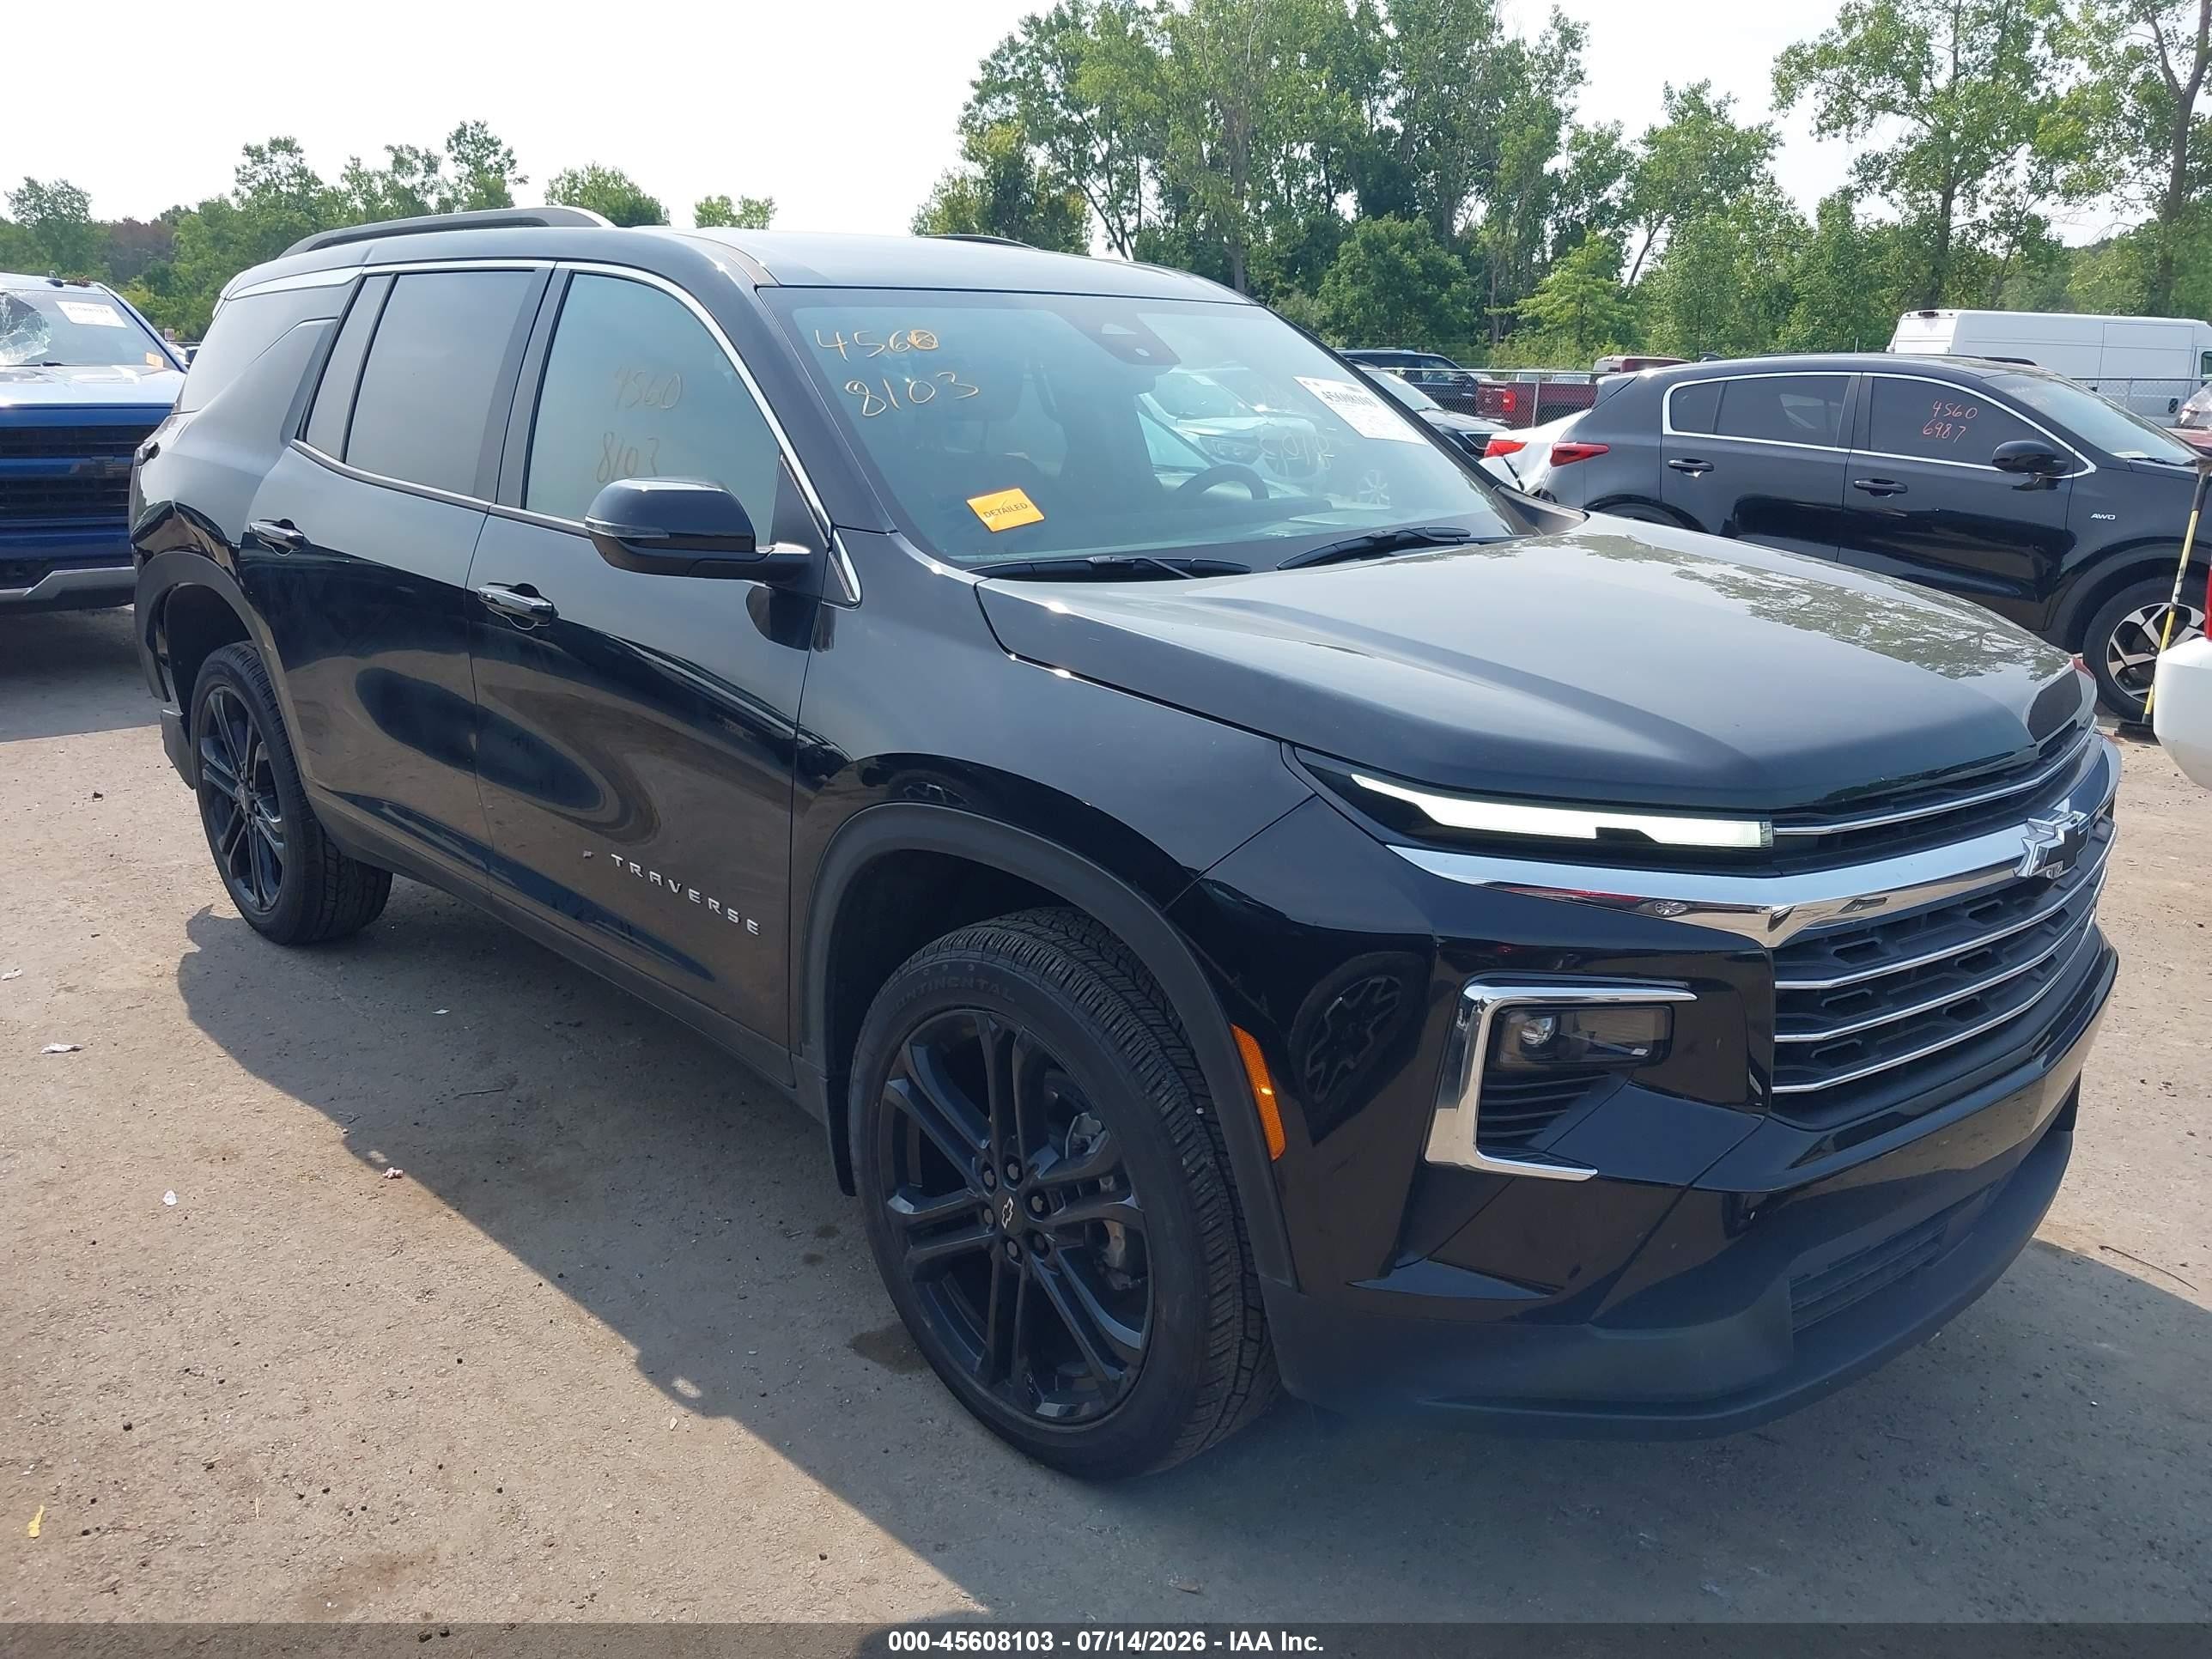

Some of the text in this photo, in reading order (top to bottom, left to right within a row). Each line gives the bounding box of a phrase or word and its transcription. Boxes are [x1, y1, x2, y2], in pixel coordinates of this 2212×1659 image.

[845, 371, 980, 416] 8103
[1932, 400, 1978, 420] 4560
[1923, 418, 1967, 444] 6987
[982, 501, 1029, 519] DETAILED
[611, 853, 760, 936] TRAVERSE
